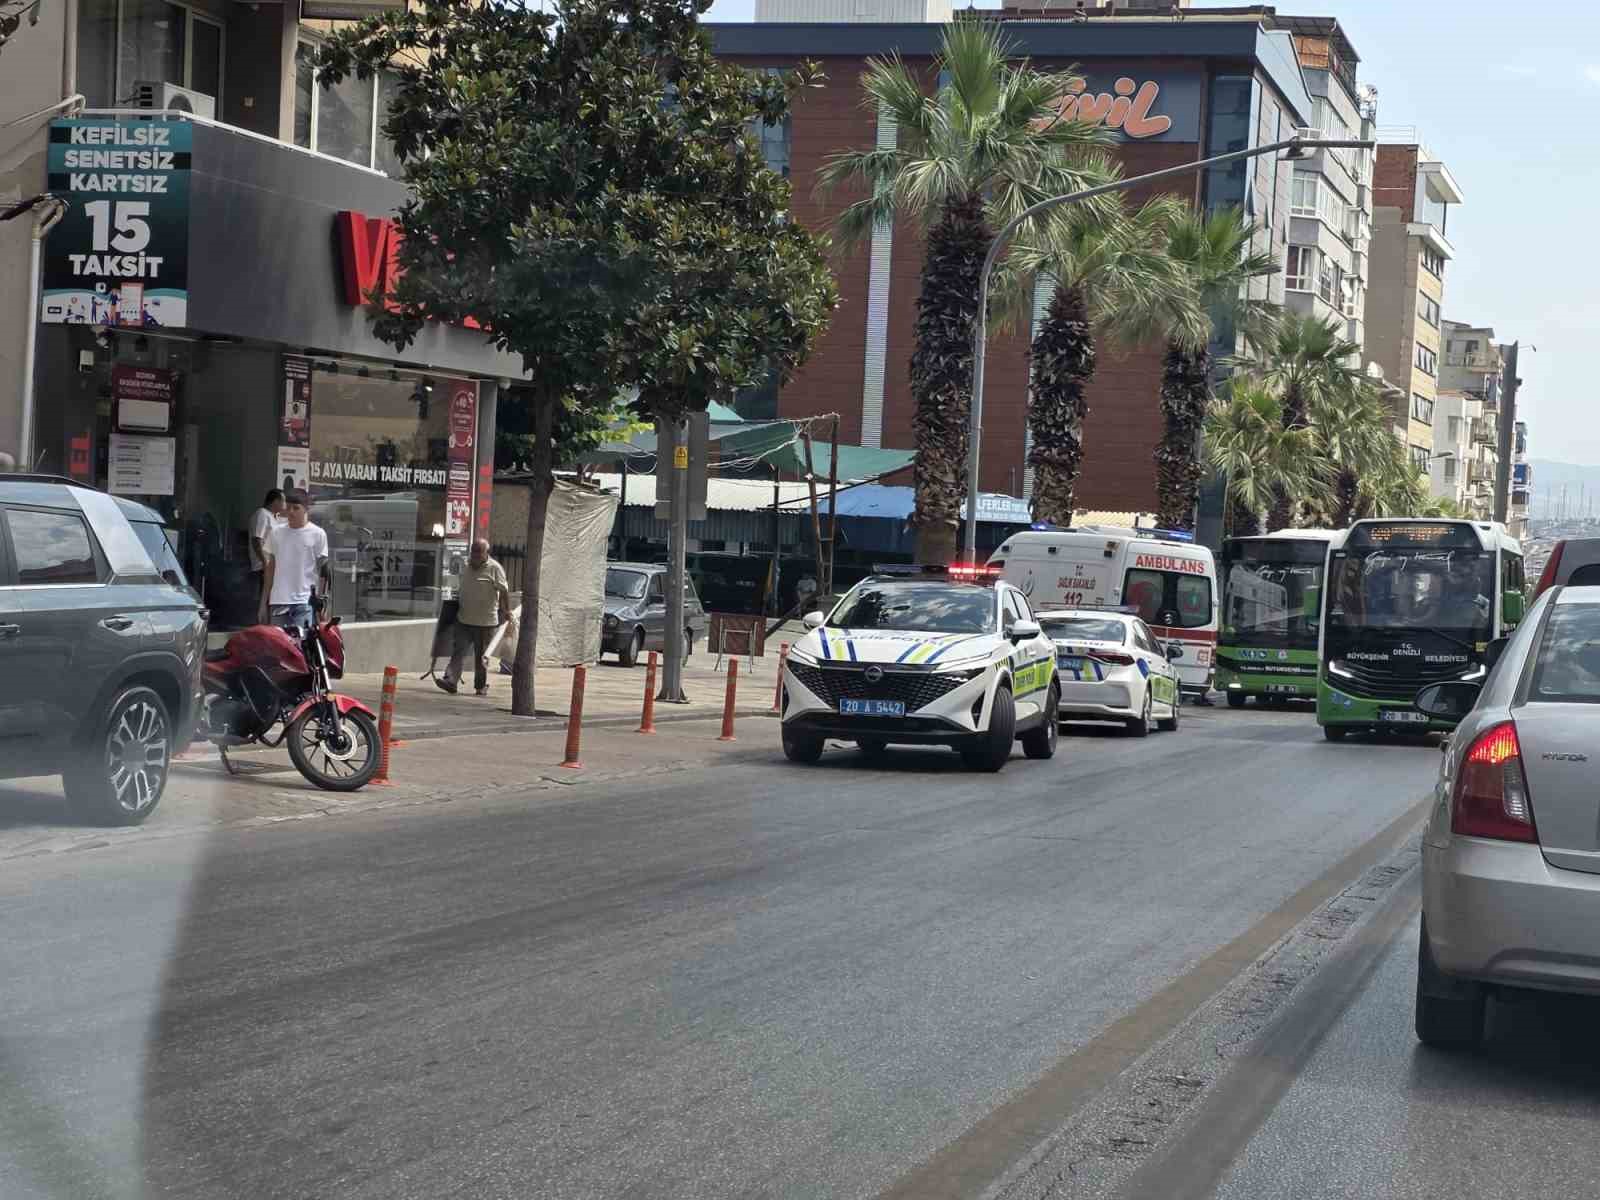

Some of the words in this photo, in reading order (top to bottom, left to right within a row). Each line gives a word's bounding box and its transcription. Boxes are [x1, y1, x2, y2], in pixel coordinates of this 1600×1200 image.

[70, 123, 170, 146] KEFİLSİZ
[64, 147, 175, 170] SENETSİZ
[69, 173, 168, 193] KARTSIZ
[84, 200, 151, 253] 15
[69, 251, 163, 278] TAKSİT
[310, 462, 321, 477] 15
[323, 462, 343, 479] AYA
[344, 463, 377, 481] VARAN
[380, 464, 413, 483] TAKSİT
[413, 469, 446, 486] FIRSATI
[1136, 554, 1205, 574] AMBULANS
[1064, 592, 1082, 606] 112
[1393, 648, 1421, 656] DENİZLİ
